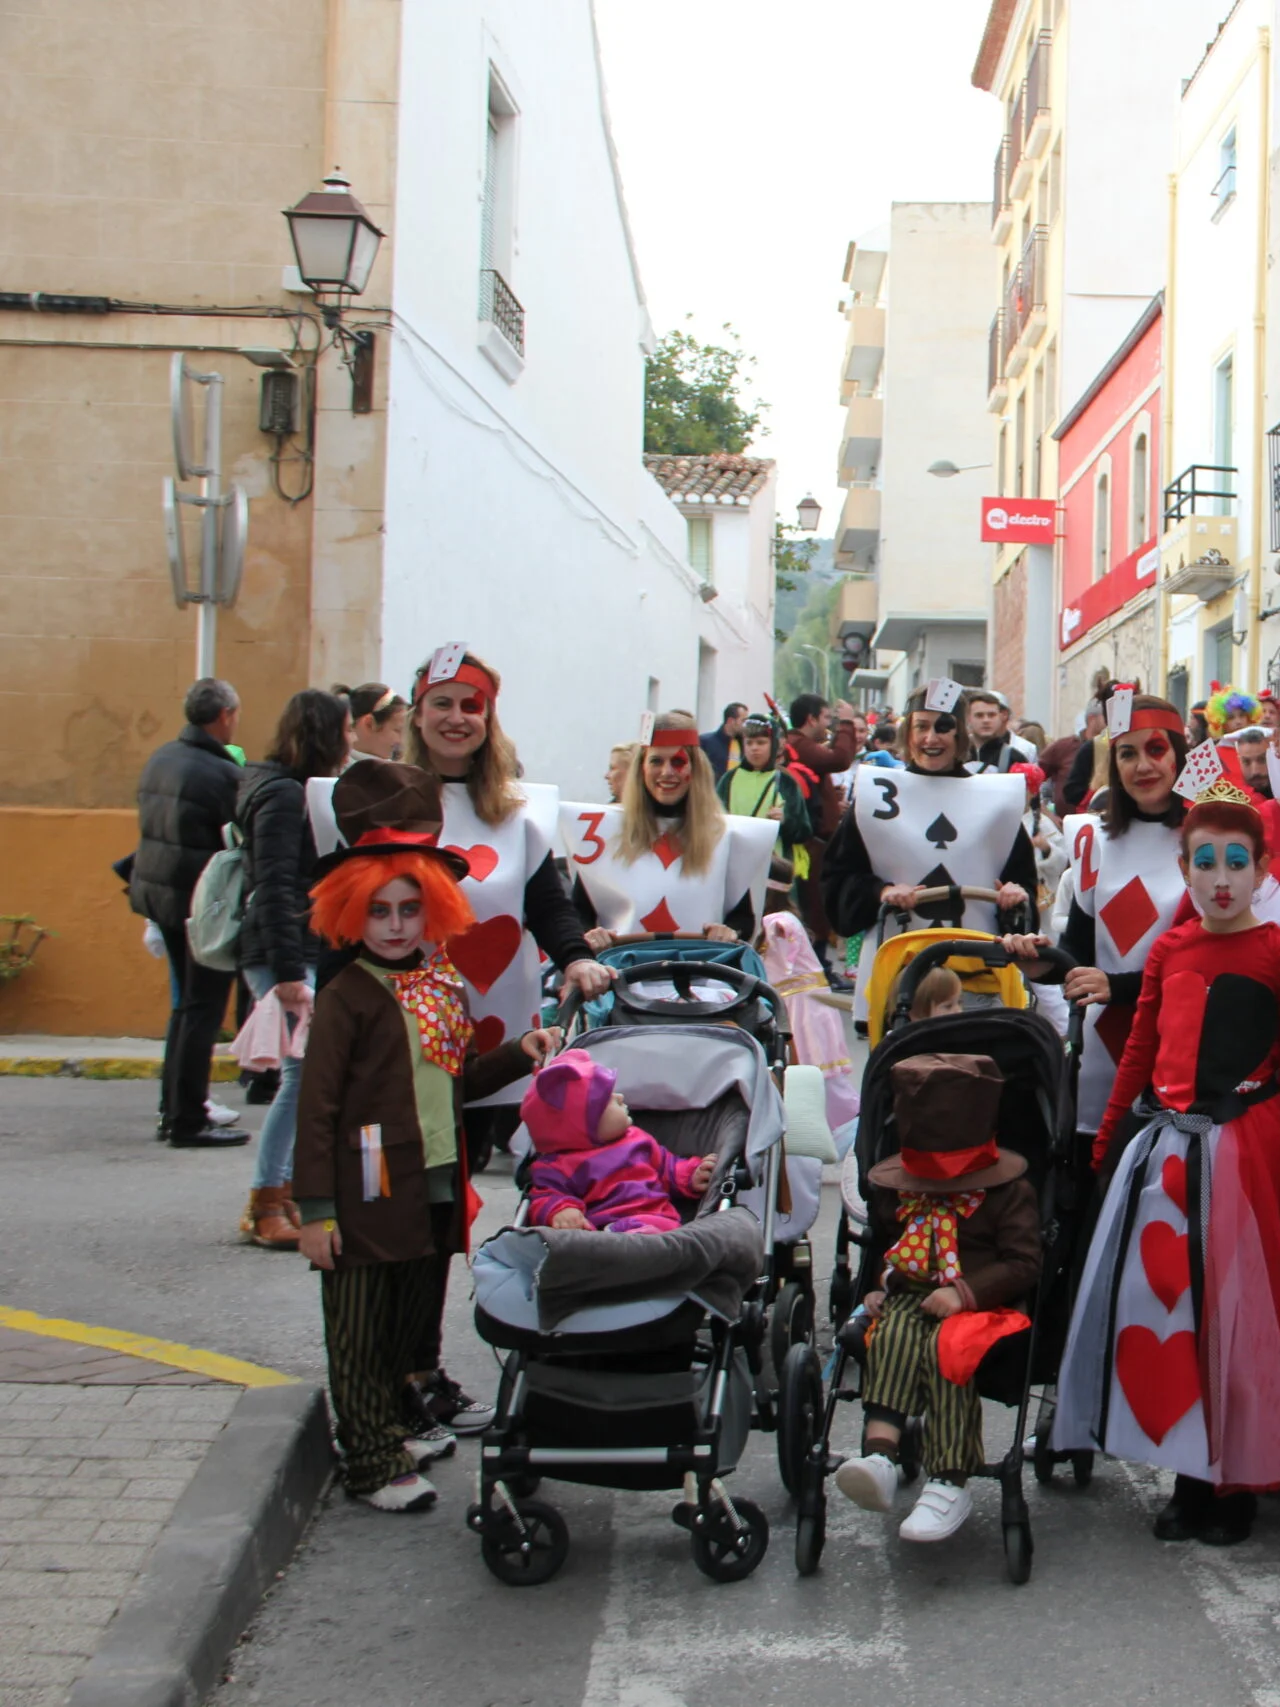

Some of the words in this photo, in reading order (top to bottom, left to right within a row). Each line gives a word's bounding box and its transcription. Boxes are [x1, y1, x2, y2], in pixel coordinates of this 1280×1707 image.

[872, 777, 900, 820] 3
[573, 812, 606, 865] 3
[1074, 823, 1099, 893] 2
